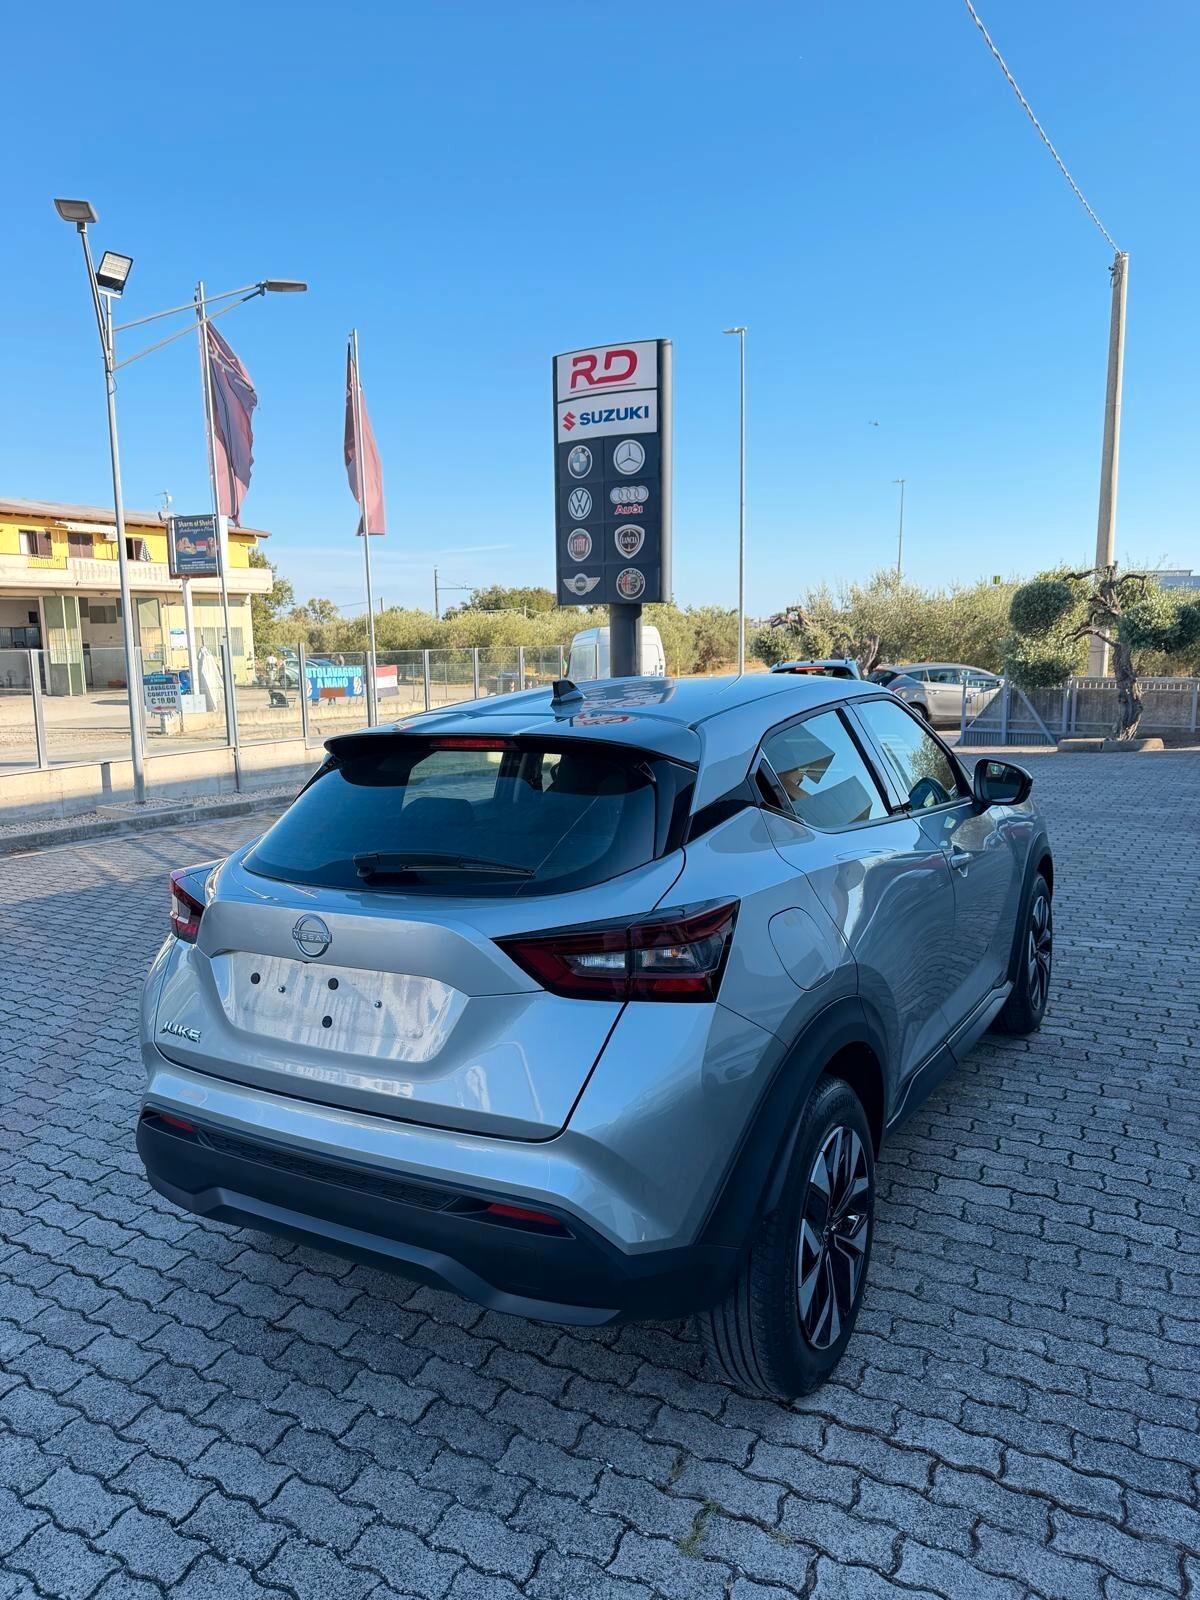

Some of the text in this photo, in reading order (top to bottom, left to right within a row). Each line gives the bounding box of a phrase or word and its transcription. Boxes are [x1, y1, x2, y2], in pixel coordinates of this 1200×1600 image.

[570, 349, 638, 389] RD
[579, 405, 649, 426] SUZUKI
[614, 503, 644, 515] Audi
[621, 536, 638, 544] LANCIA
[304, 666, 362, 678] UTOLAVAGGIO
[317, 677, 349, 688] A MANO
[292, 930, 331, 943] NISSAN
[160, 1021, 201, 1043] JUKE
